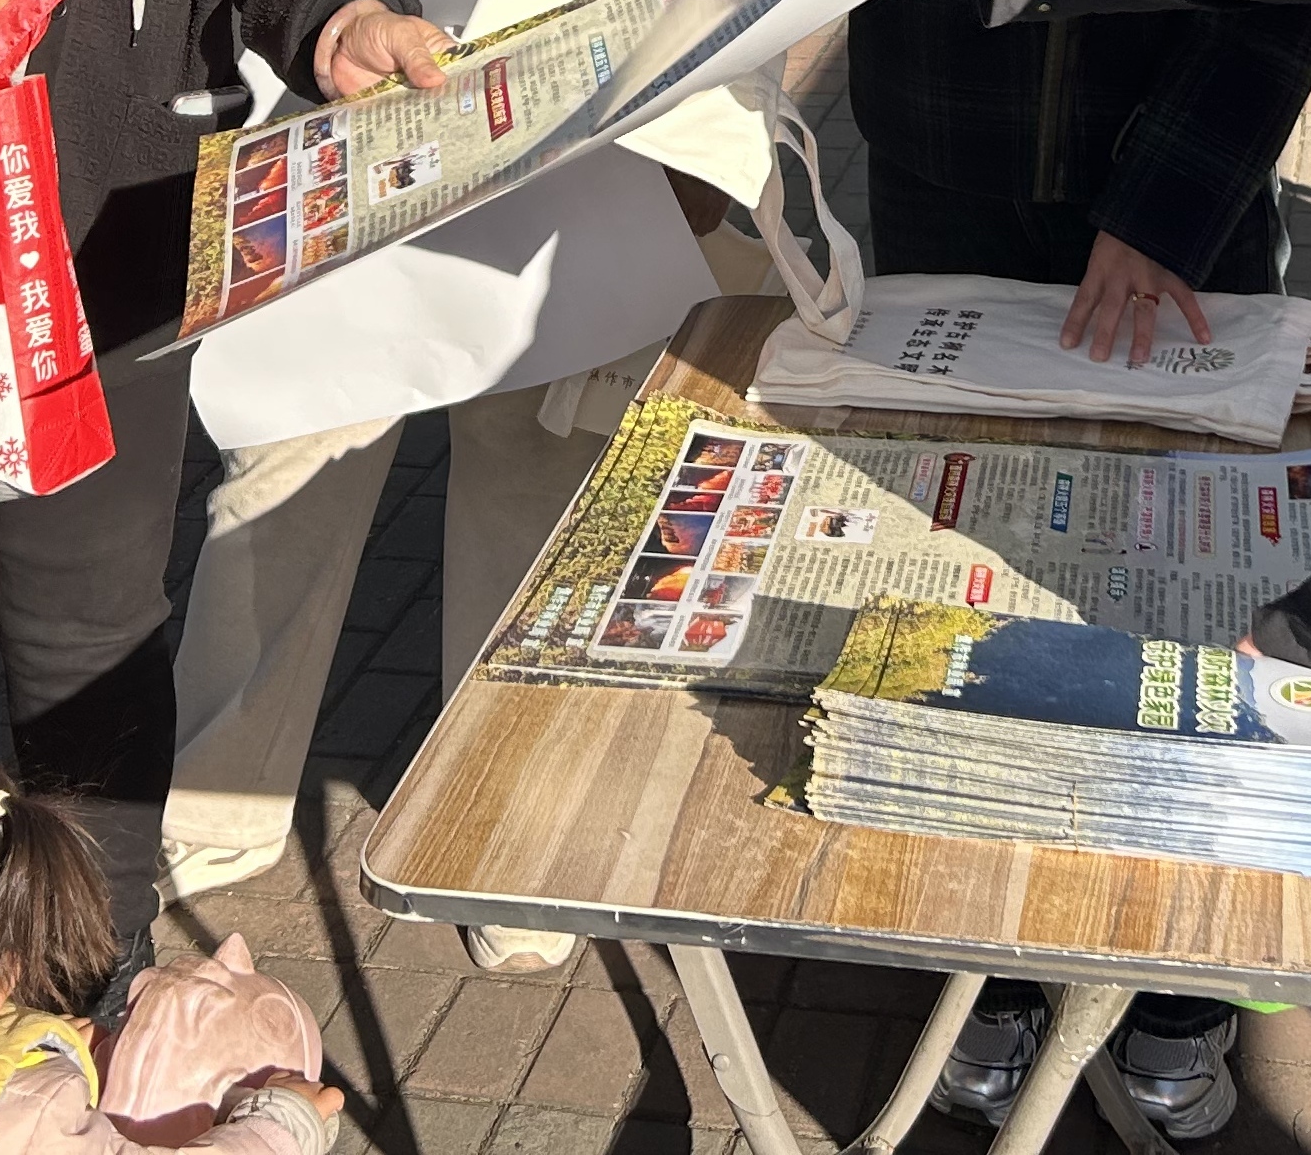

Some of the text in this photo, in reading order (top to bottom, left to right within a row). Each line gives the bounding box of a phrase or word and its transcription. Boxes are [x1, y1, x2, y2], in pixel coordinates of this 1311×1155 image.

[19, 281, 60, 384] 我爱你
[893, 308, 951, 373] 传承生态文明
[925, 309, 985, 376] 保护古树名木
[1137, 641, 1181, 730] 守护绿色家园
[1196, 646, 1238, 734] 预防森林火灾
